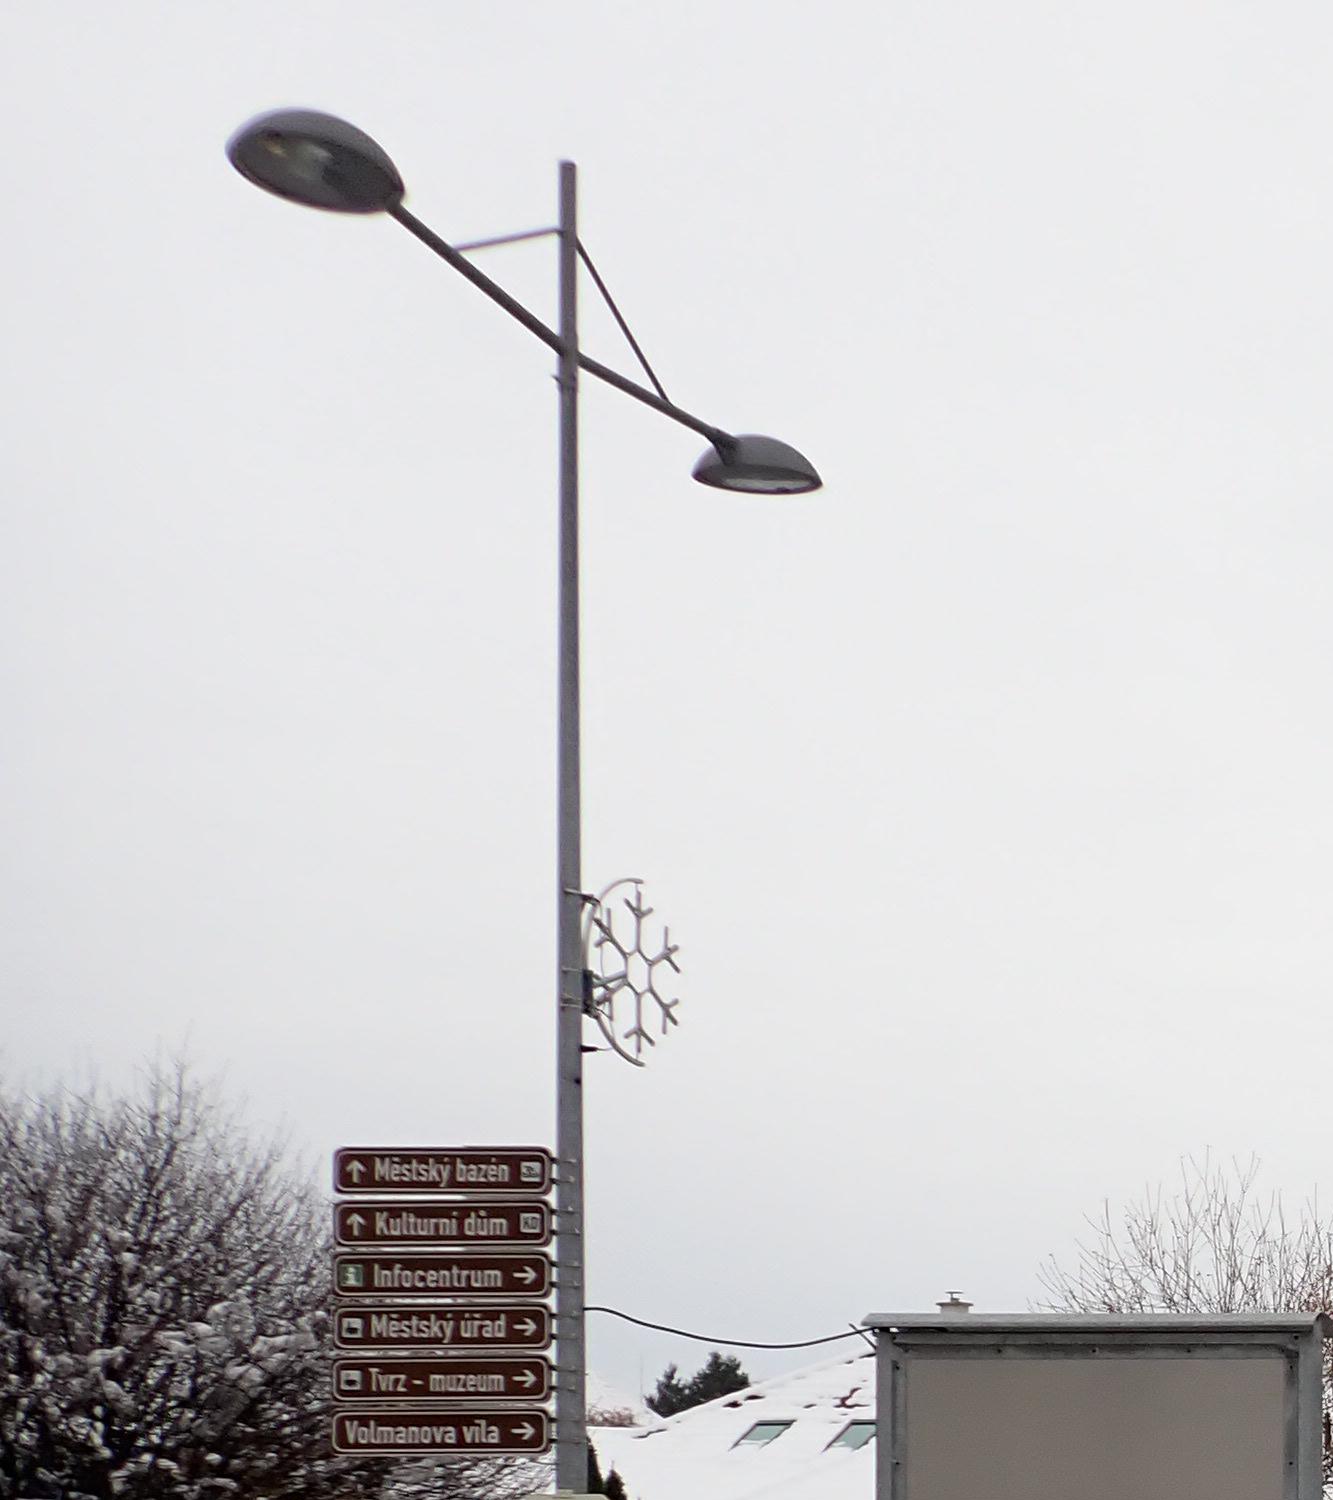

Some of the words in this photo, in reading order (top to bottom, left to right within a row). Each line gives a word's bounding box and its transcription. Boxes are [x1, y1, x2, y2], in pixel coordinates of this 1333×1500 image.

[374, 1156, 450, 1187] Městský
[456, 1157, 509, 1182] bazén
[375, 1210, 459, 1236] Kulturní
[464, 1209, 508, 1236] dům
[373, 1263, 503, 1288] Infocentrum
[370, 1312, 453, 1343] Městský
[460, 1312, 507, 1338] úřad
[368, 1367, 408, 1392] Tvrz
[429, 1374, 506, 1392] muzeum
[344, 1419, 457, 1444] Volmanova
[462, 1419, 500, 1444] vila
